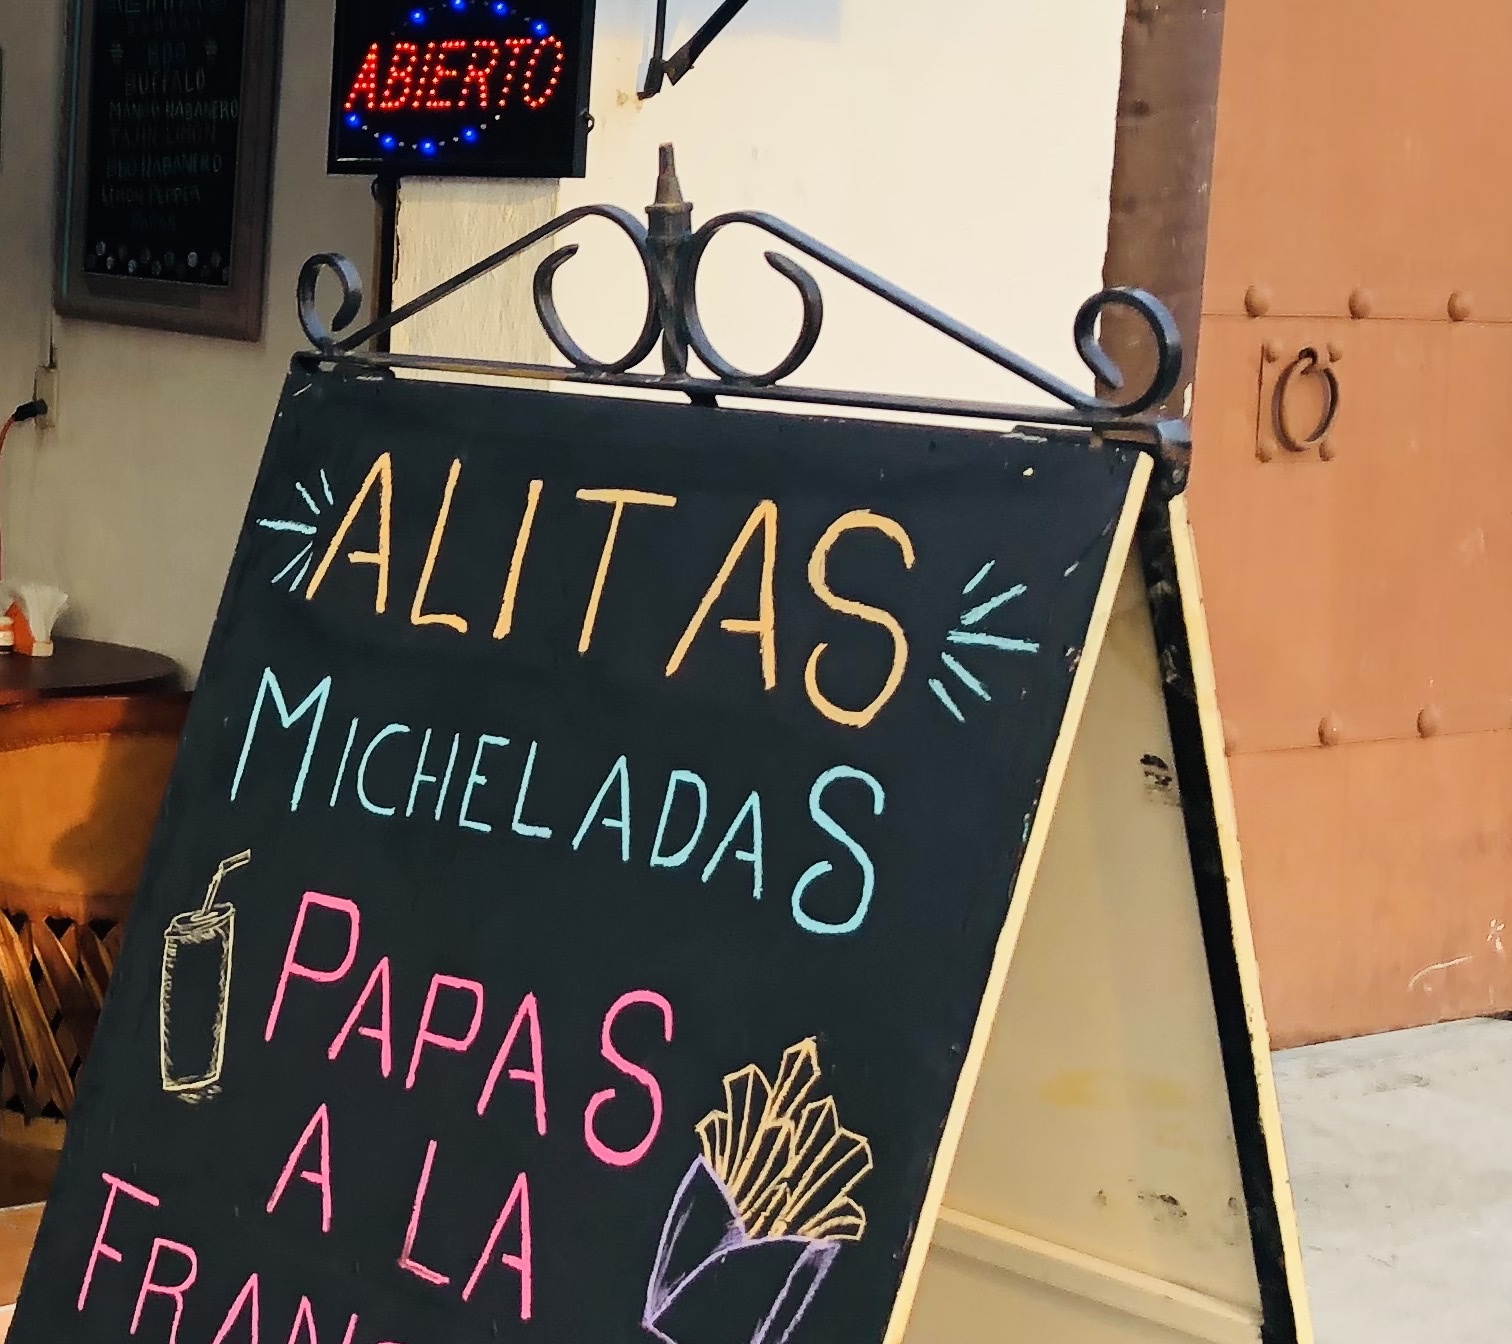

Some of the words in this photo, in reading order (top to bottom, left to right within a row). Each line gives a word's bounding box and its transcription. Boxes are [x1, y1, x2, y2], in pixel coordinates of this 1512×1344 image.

[344, 35, 565, 109] ABIERTO
[306, 451, 916, 728] ALITAS
[229, 666, 885, 935] MICHELADAS
[264, 890, 674, 1168] PAPAS
[266, 1102, 333, 1233] A
[397, 1139, 533, 1321] LA
